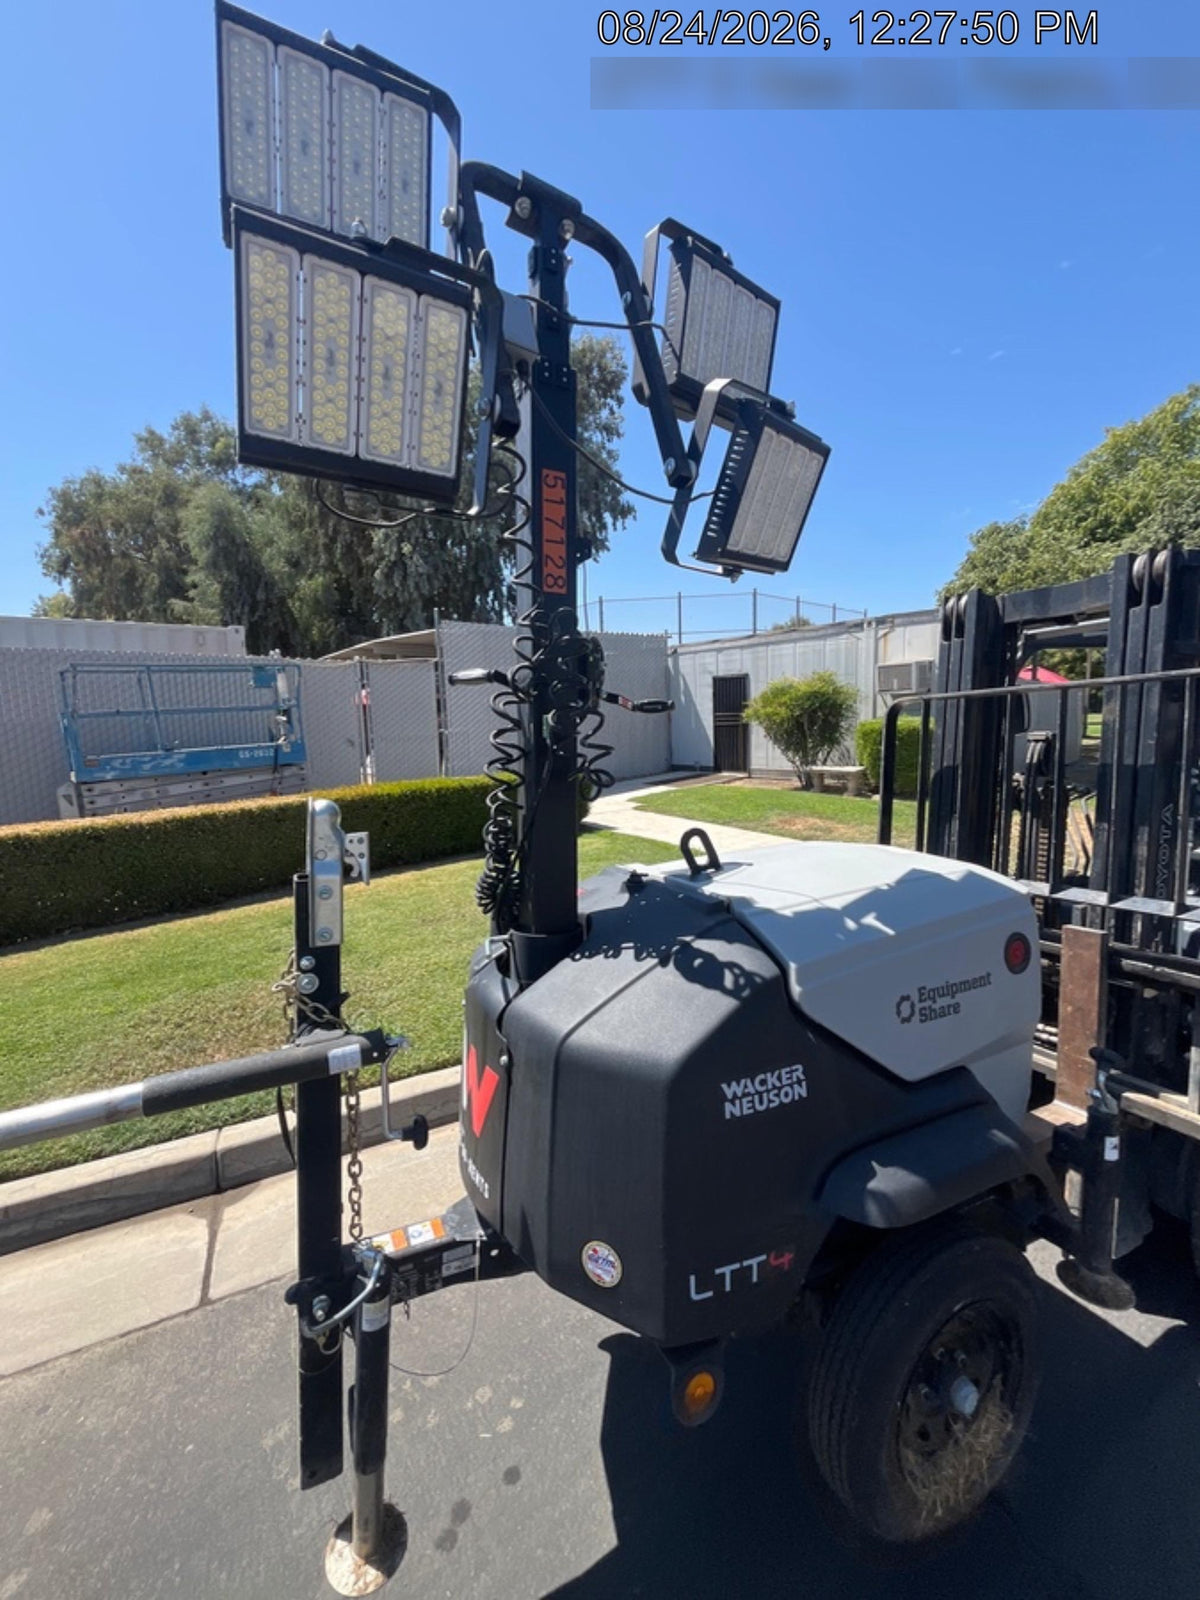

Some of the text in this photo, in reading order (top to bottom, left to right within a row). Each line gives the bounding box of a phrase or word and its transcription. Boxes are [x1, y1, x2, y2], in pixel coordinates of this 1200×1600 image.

[543, 473, 567, 588] 517128
[1156, 803, 1174, 899] OYOTA
[918, 971, 992, 1004] Equipment
[919, 1002, 961, 1023] Share
[721, 1064, 806, 1099] WACKER
[724, 1080, 807, 1119] NEUSON
